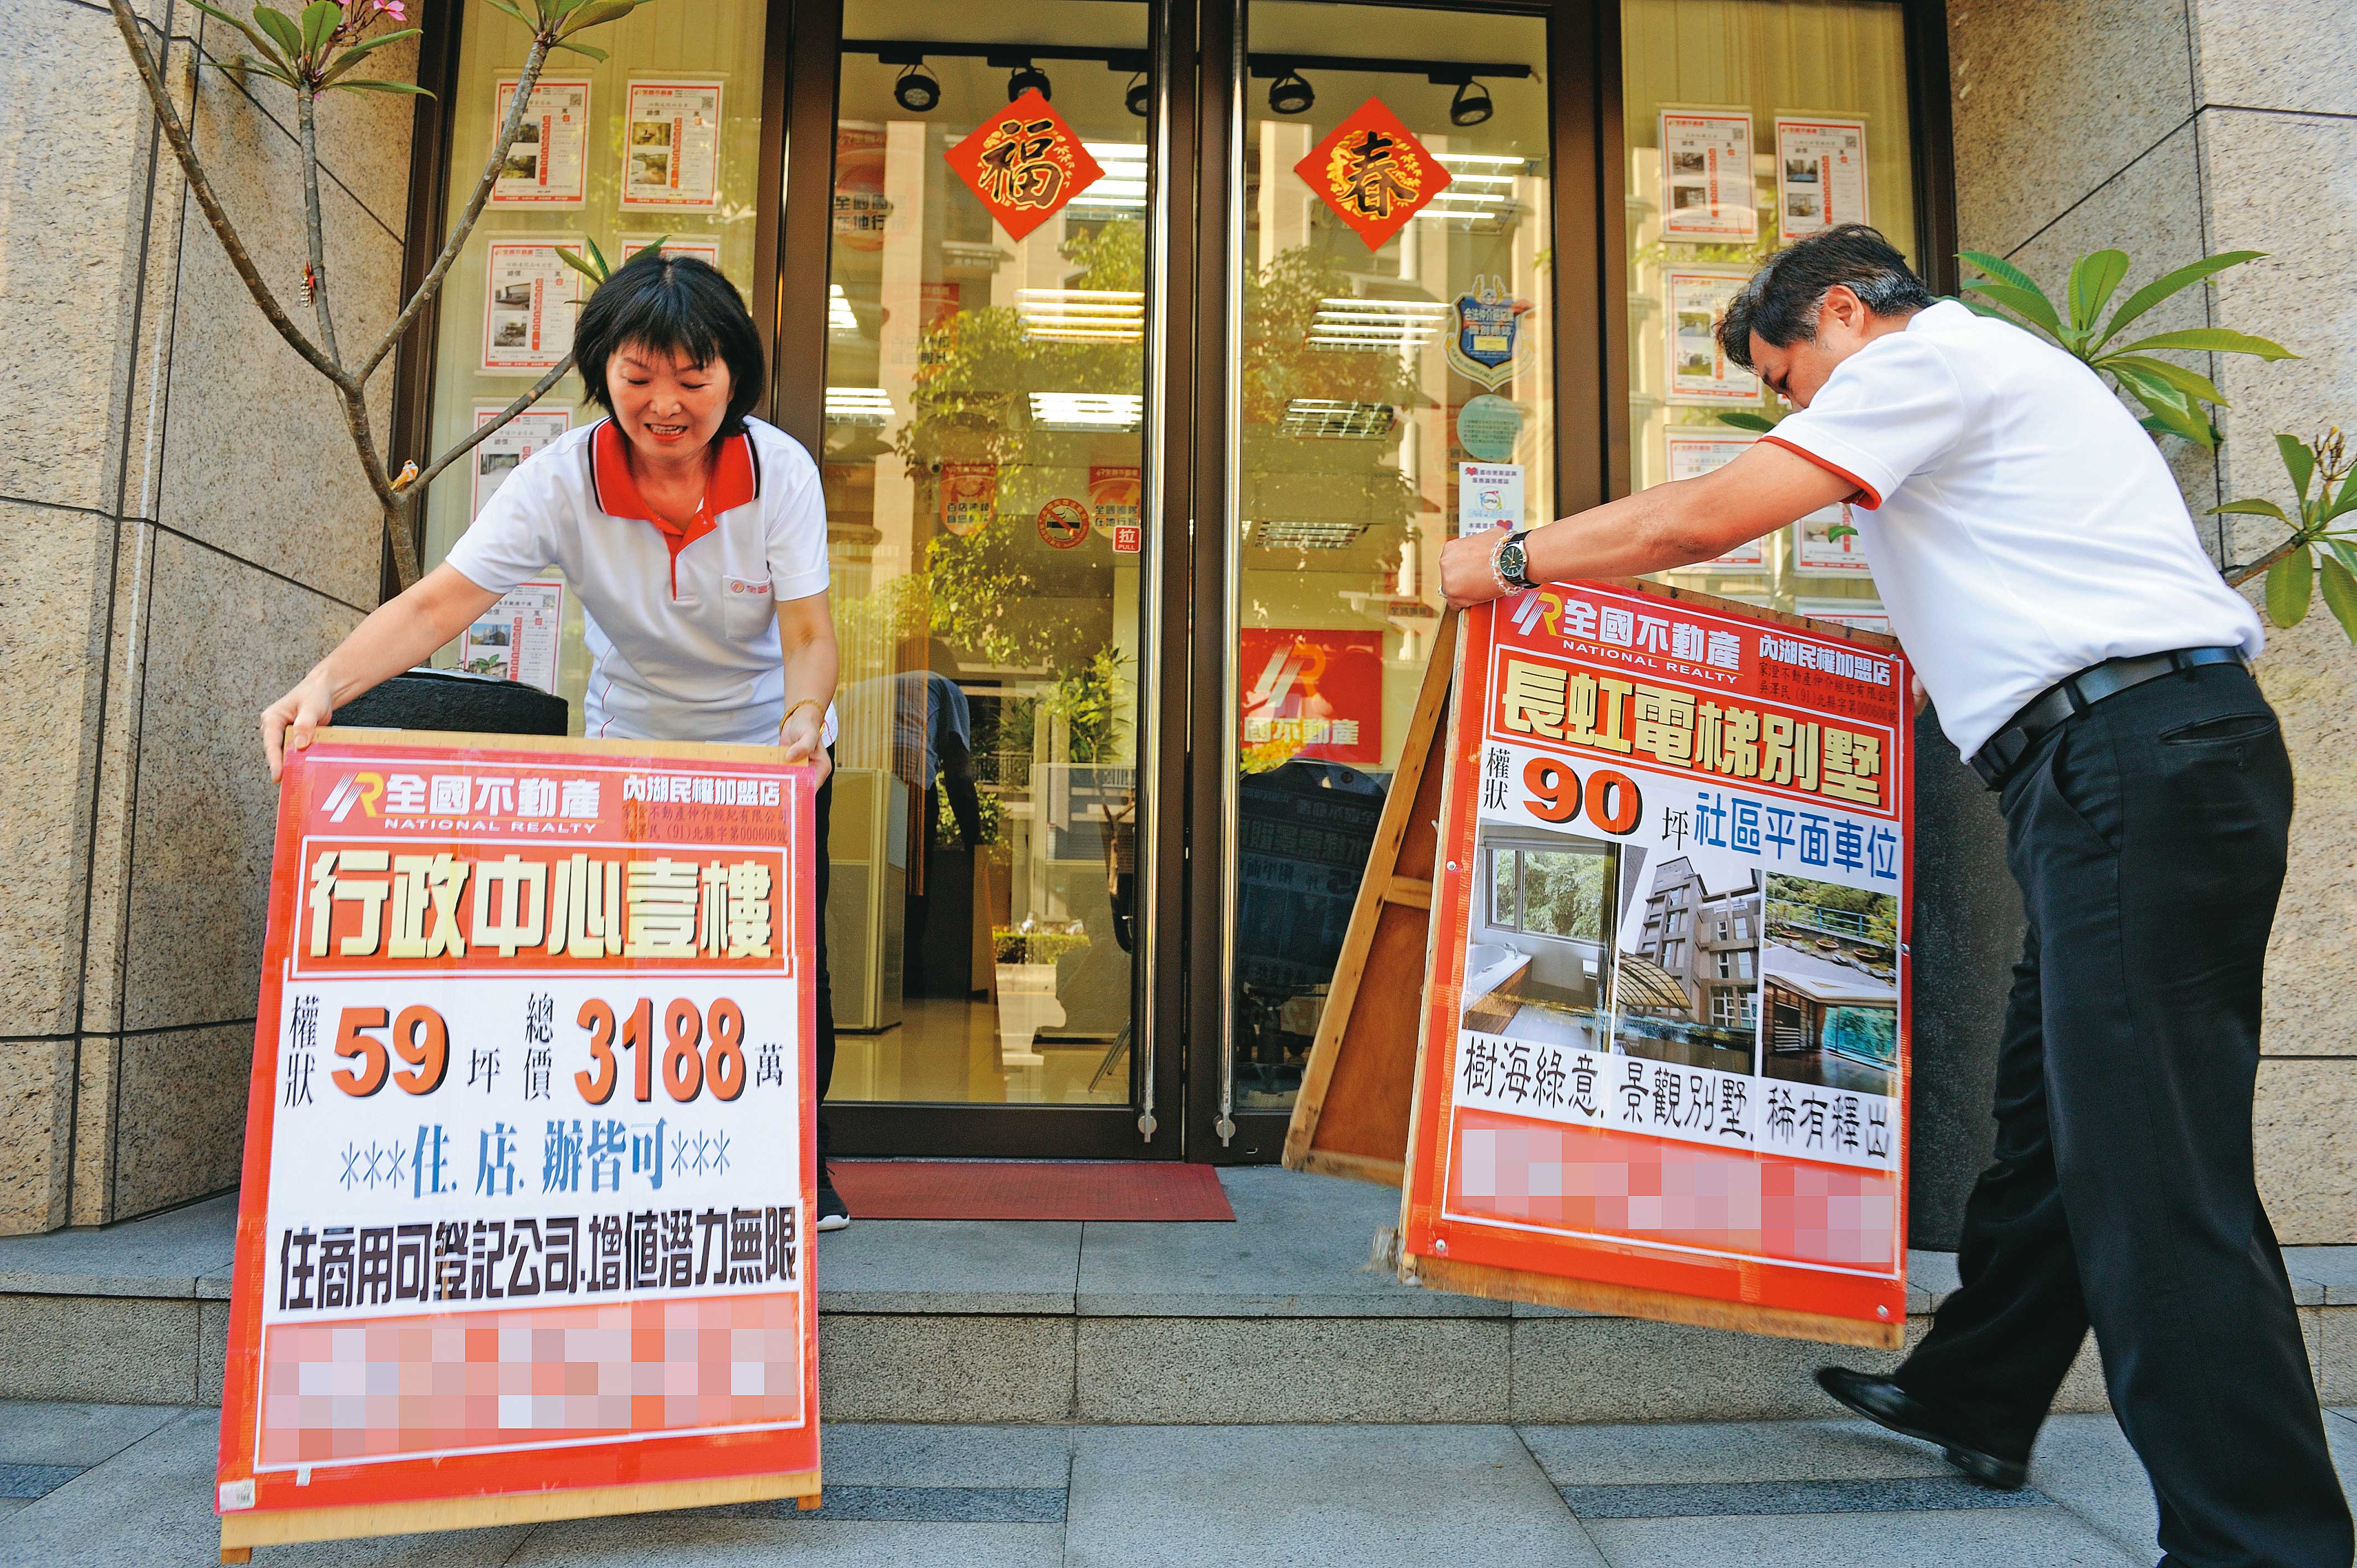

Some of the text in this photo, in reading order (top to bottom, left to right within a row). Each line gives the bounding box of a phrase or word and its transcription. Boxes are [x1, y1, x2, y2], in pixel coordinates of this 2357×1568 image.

[978, 117, 1064, 209] 福
[1336, 131, 1420, 218] 春
[1119, 529, 1135, 543] 拉
[1563, 597, 1741, 672] 全國不動產
[1563, 639, 1738, 685] NATIONAL REALTY
[1502, 661, 1881, 806] 長虹電梯別墅
[385, 773, 600, 818] 全國不動產
[385, 819, 596, 833] NATIONAL REALTY
[1522, 757, 1643, 835] 90
[1662, 807, 1689, 852] 坪
[1694, 792, 1898, 881] 社區平面車位
[309, 850, 773, 960] 行政中心壹樓
[331, 1004, 451, 1098] 59
[467, 1048, 501, 1096] 坪
[524, 992, 554, 1102] 總價
[574, 997, 746, 1105] 3188
[755, 1043, 784, 1088] 萬
